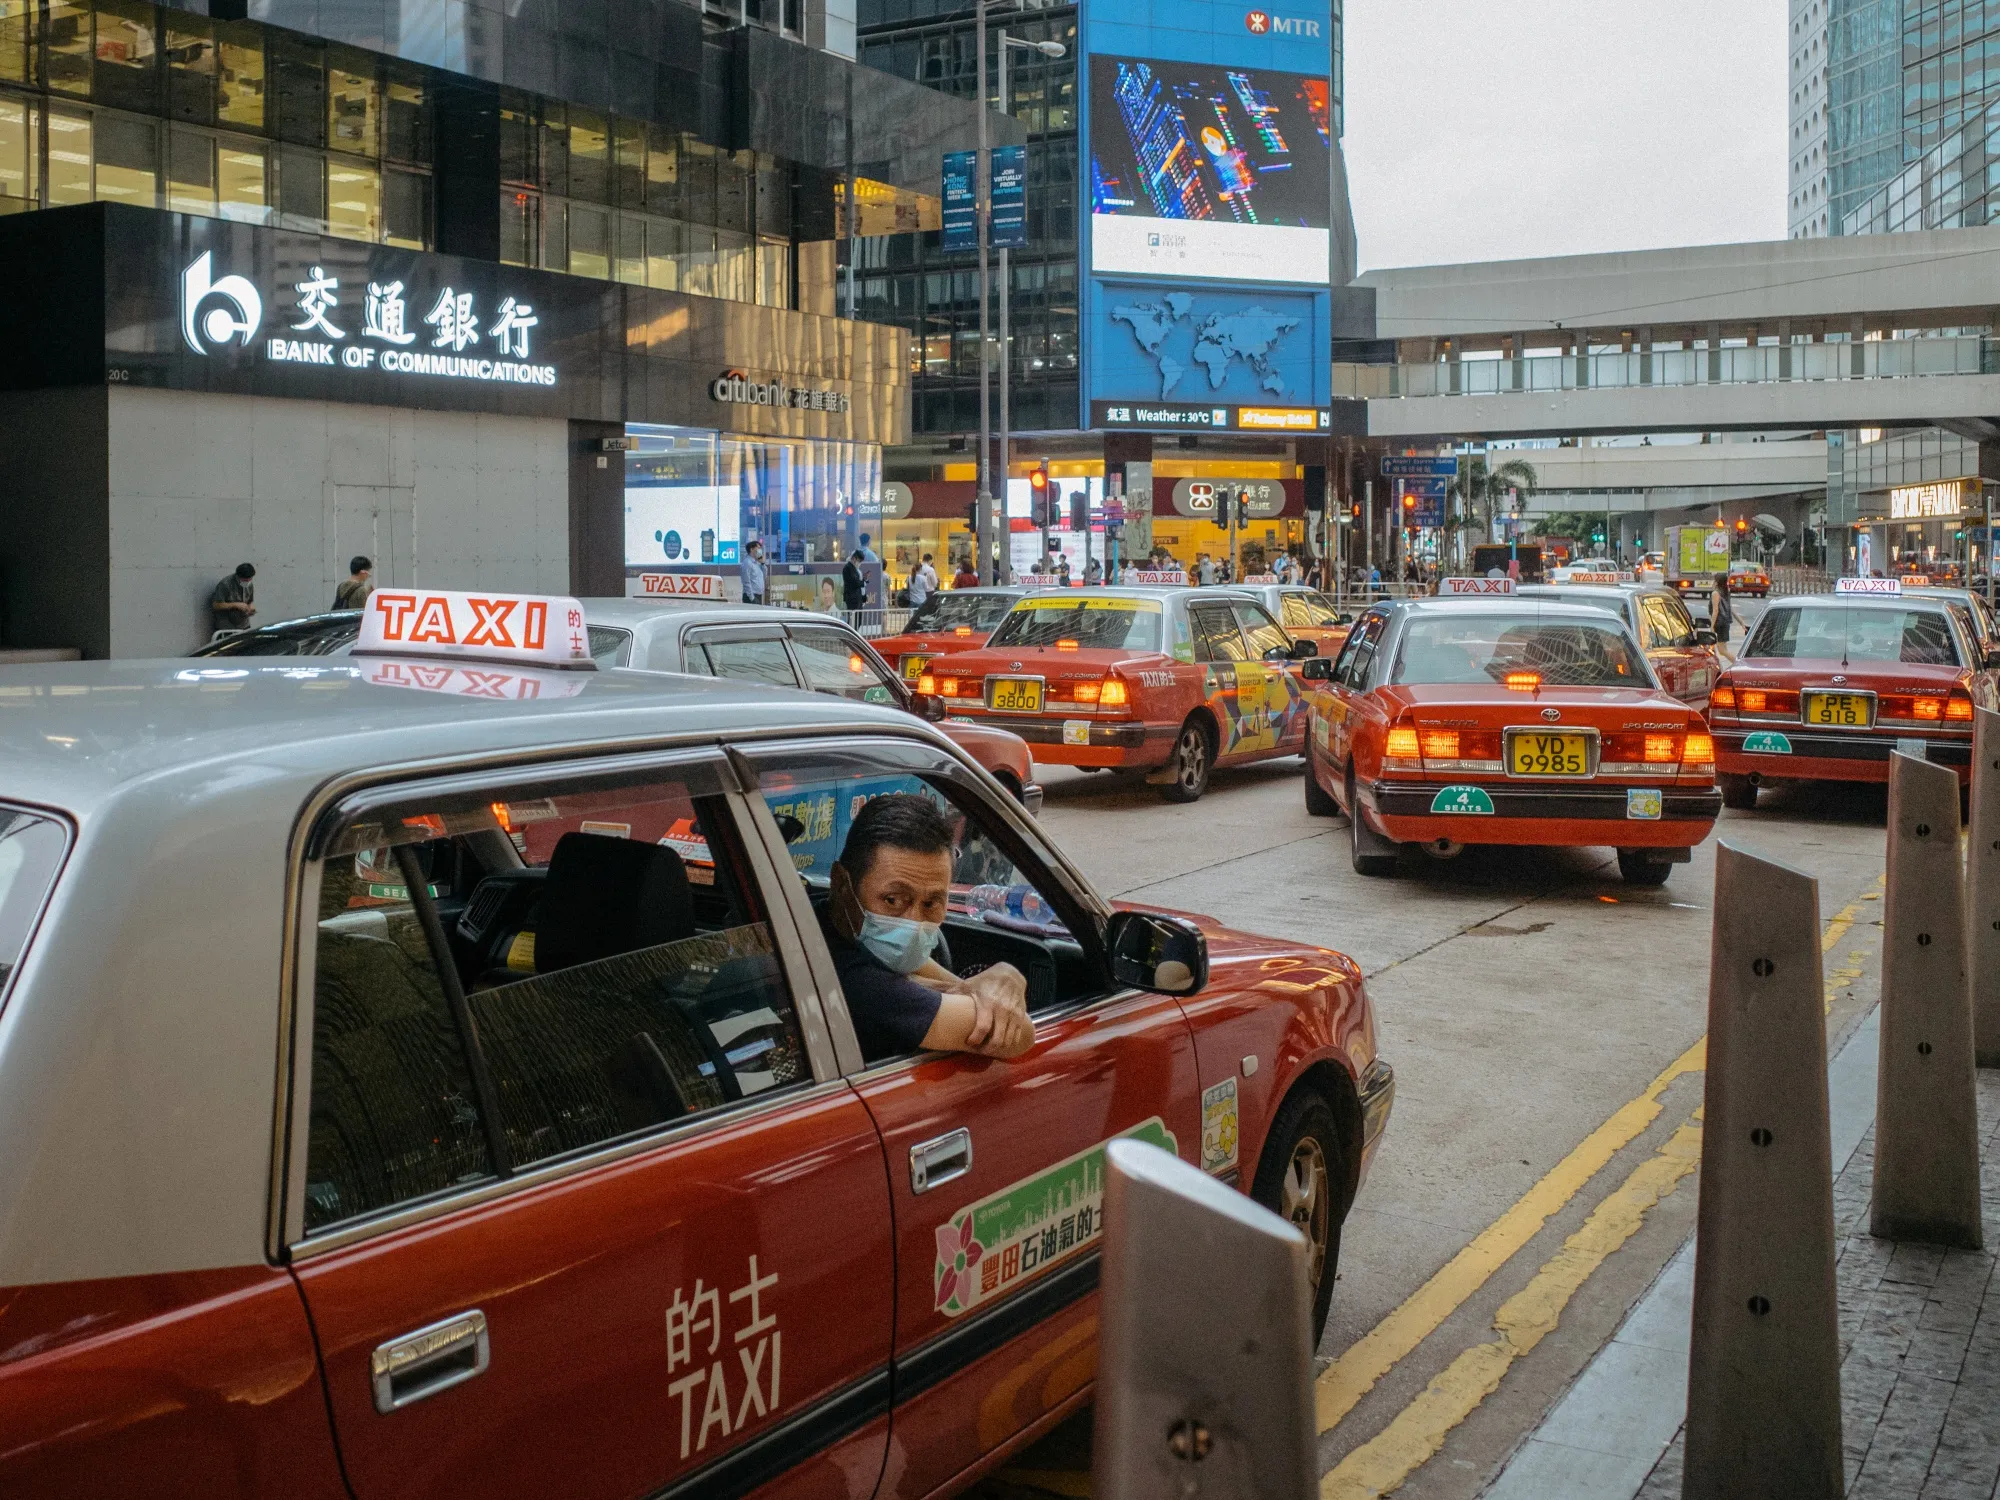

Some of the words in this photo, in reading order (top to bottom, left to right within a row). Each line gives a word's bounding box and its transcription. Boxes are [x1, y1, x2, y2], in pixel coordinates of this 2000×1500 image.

[1273, 16, 1320, 38] MTR
[947, 176, 967, 184] HONG
[994, 174, 1022, 182] VIRTUALLY
[291, 266, 539, 358] 交通銀行
[266, 339, 334, 365] BANK
[342, 347, 375, 368] OF
[380, 350, 556, 385] COMMUNICATIONS
[715, 374, 789, 407] citibank
[643, 575, 712, 594] TAXI
[1020, 576, 1054, 584] TAXI
[1137, 573, 1181, 583] TAXI
[1573, 573, 1614, 582] TAXI
[1449, 579, 1510, 593] TAXI
[1842, 580, 1896, 591] TAXI
[376, 594, 548, 650] TAXI
[568, 609, 583, 650] 的士
[1140, 671, 1160, 687] TAXI
[1008, 683, 1027, 695] JW
[997, 695, 1036, 708] 3800
[1826, 696, 1852, 710] PE
[1820, 710, 1856, 723] 918
[1535, 735, 1564, 754] VD
[1763, 737, 1772, 745] 4
[1520, 754, 1580, 773] 9985
[1456, 792, 1469, 805] 4
[383, 887, 409, 898] SEA
[665, 1254, 779, 1374] 的士
[667, 1331, 781, 1460] TAXI
